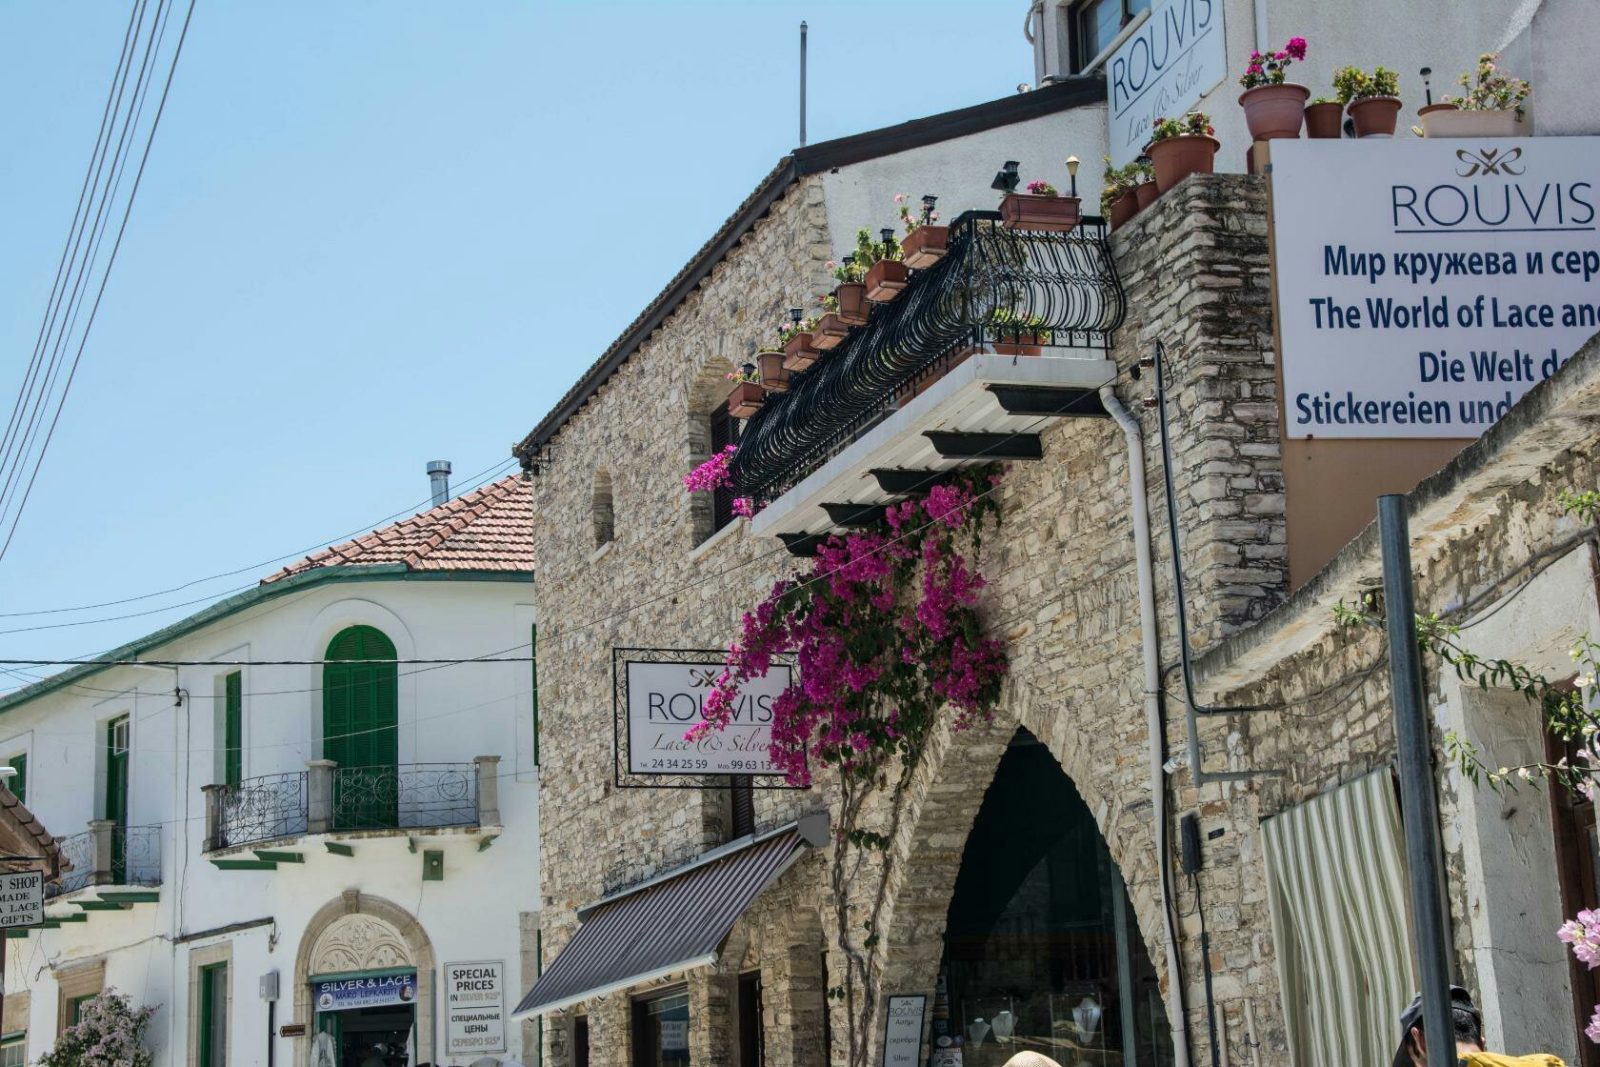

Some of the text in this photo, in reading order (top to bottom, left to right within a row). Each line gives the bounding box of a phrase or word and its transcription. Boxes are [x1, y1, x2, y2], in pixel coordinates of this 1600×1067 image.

[1391, 182, 1595, 227] ROUVIS
[1324, 245, 1600, 285] Мир кружева и сер
[1309, 295, 1600, 329] The World of Lace an
[1419, 349, 1466, 383] Die
[1470, 349, 1535, 383] Welt
[1296, 390, 1451, 425] Stickereien
[649, 732, 690, 751] Lace
[652, 759, 664, 769] 24
[666, 759, 679, 769] 34
[681, 759, 694, 769] 25
[695, 759, 708, 769] 59
[730, 760, 743, 770] 99
[745, 760, 757, 770] 63
[9, 876, 39, 890] SHOP
[10, 902, 39, 912] LACE
[1, 914, 33, 924] GIFTS
[452, 968, 497, 980] SPECIAL
[321, 975, 412, 993] SILVER & LACE
[456, 980, 494, 991] PRICES
[451, 1013, 500, 1022] СПЕЦИАЛЬНЫЕ
[464, 1025, 488, 1034] ЦЕНЫ
